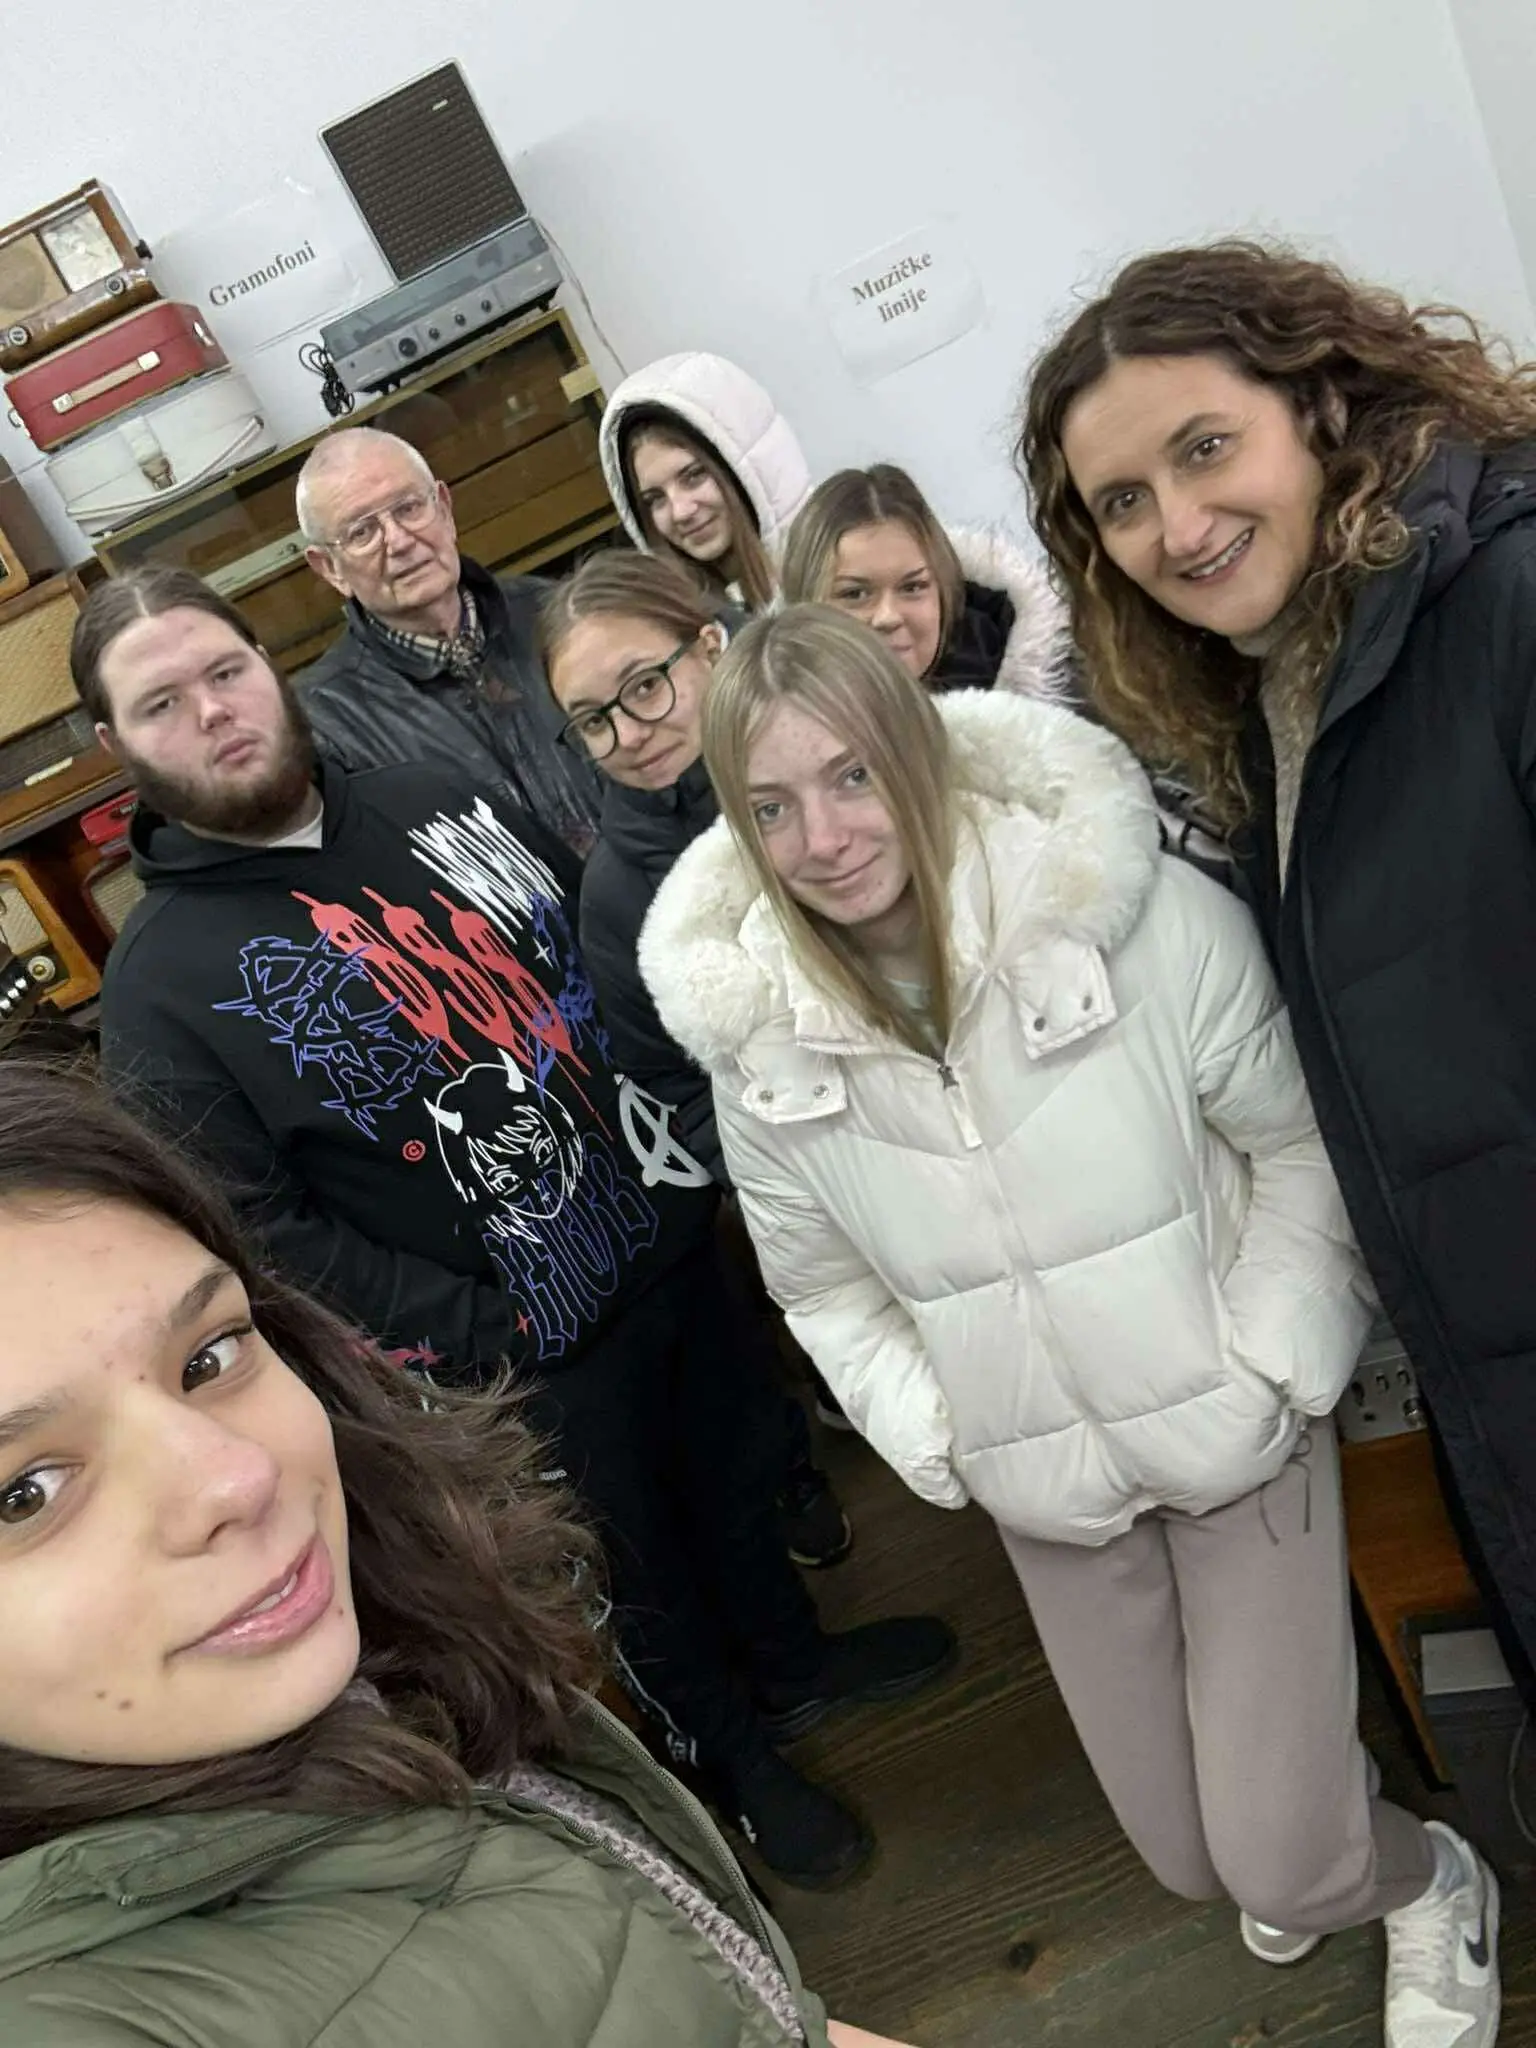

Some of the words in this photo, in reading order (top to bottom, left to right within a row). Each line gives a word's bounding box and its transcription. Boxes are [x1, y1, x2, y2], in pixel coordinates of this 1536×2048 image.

[209, 240, 316, 306] Gramofoni
[852, 253, 932, 305] Muzičke
[878, 288, 928, 322] linije
